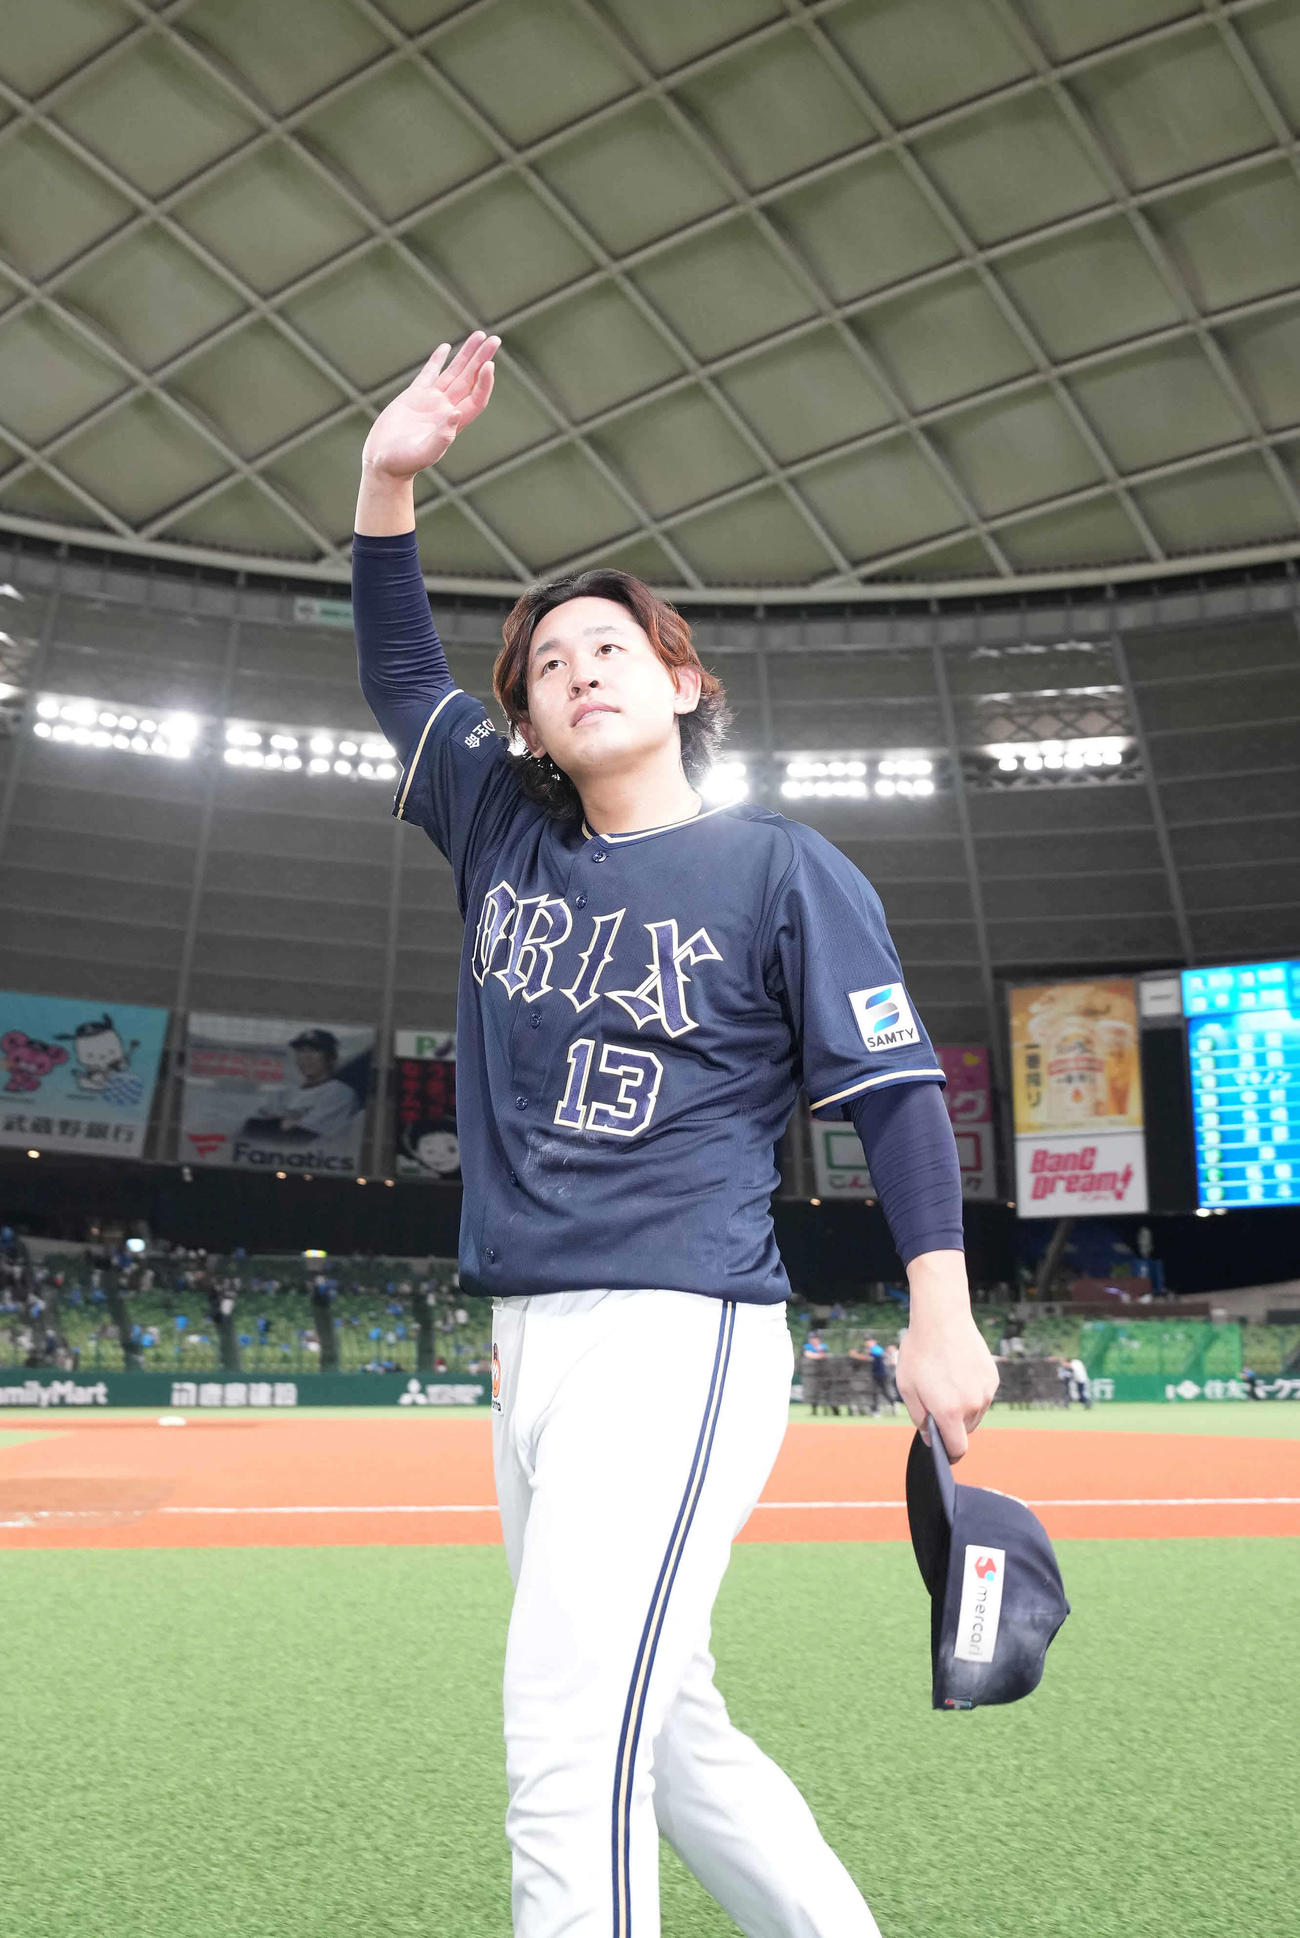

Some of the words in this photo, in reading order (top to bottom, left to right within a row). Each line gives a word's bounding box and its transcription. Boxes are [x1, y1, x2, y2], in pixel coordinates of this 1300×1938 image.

[471, 880, 724, 1039] ORIX
[867, 1027, 914, 1047] SAMTY
[553, 1038, 664, 1137] 13
[233, 1142, 354, 1170] Fanatics
[968, 1586, 988, 1656] mercari
